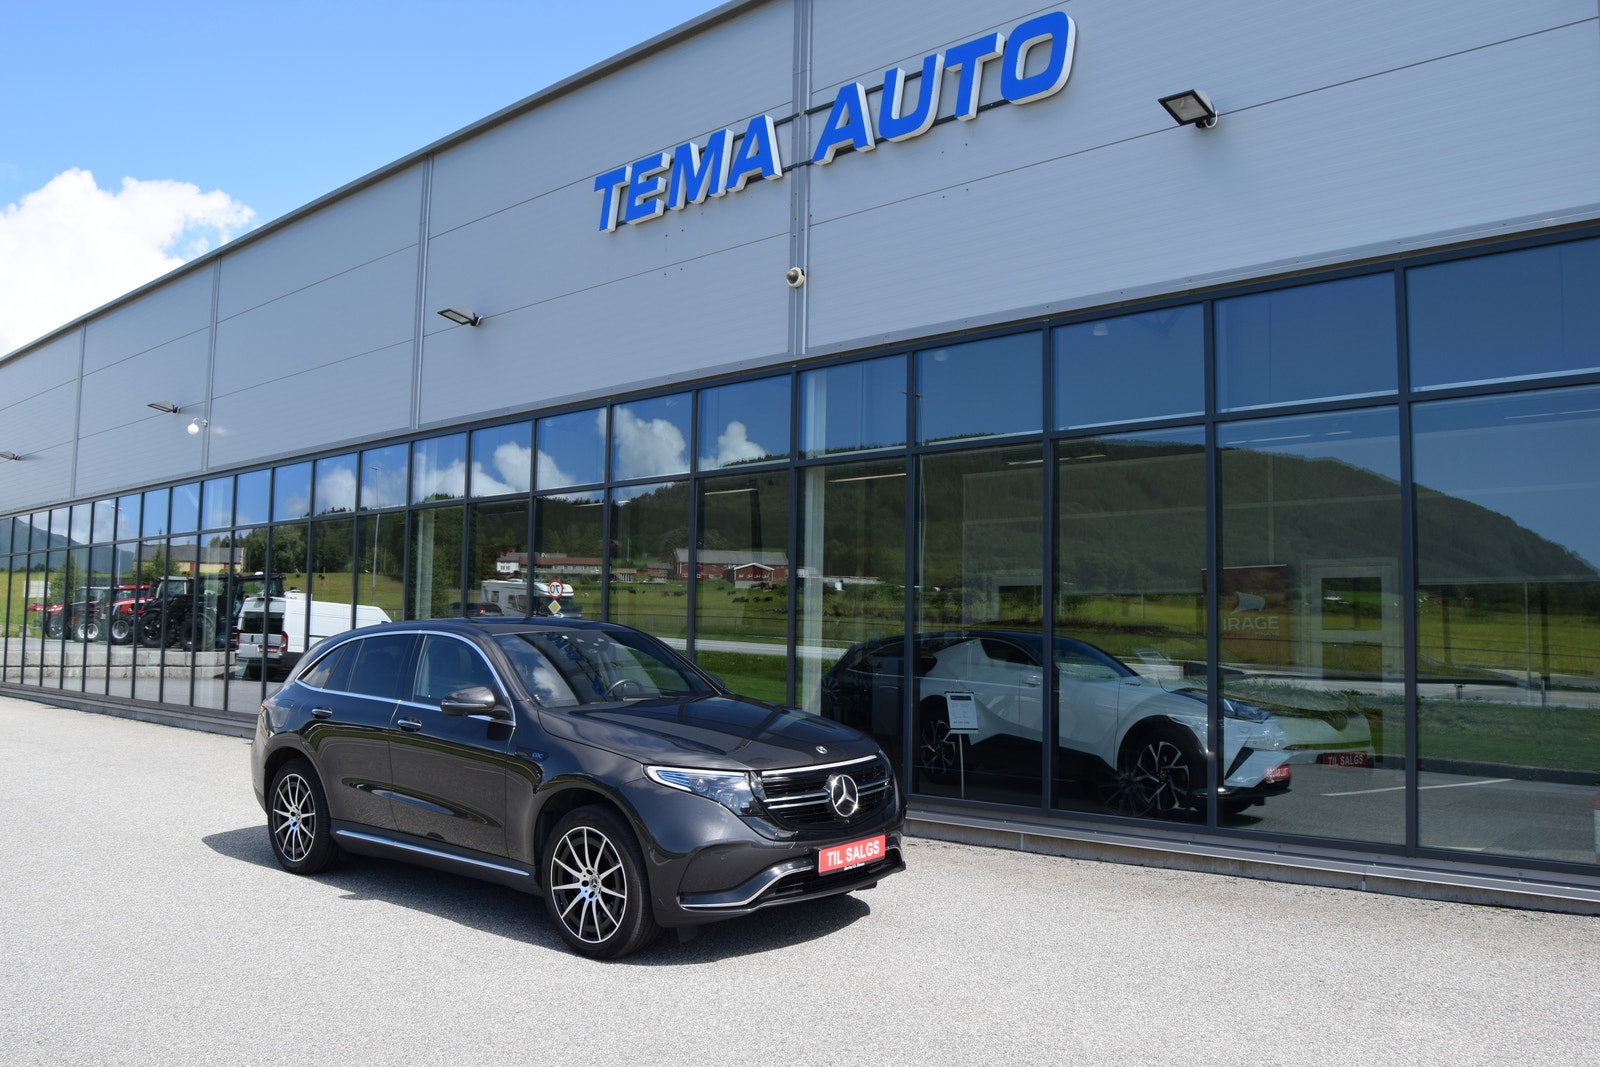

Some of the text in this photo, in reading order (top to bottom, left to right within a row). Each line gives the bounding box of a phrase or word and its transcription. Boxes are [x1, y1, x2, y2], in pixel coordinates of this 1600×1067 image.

[594, 11, 1077, 233] TEMA AUTO
[1328, 754, 1364, 767] TIL SALGS
[826, 850, 844, 867] TIL
[845, 839, 880, 863] SALGS
